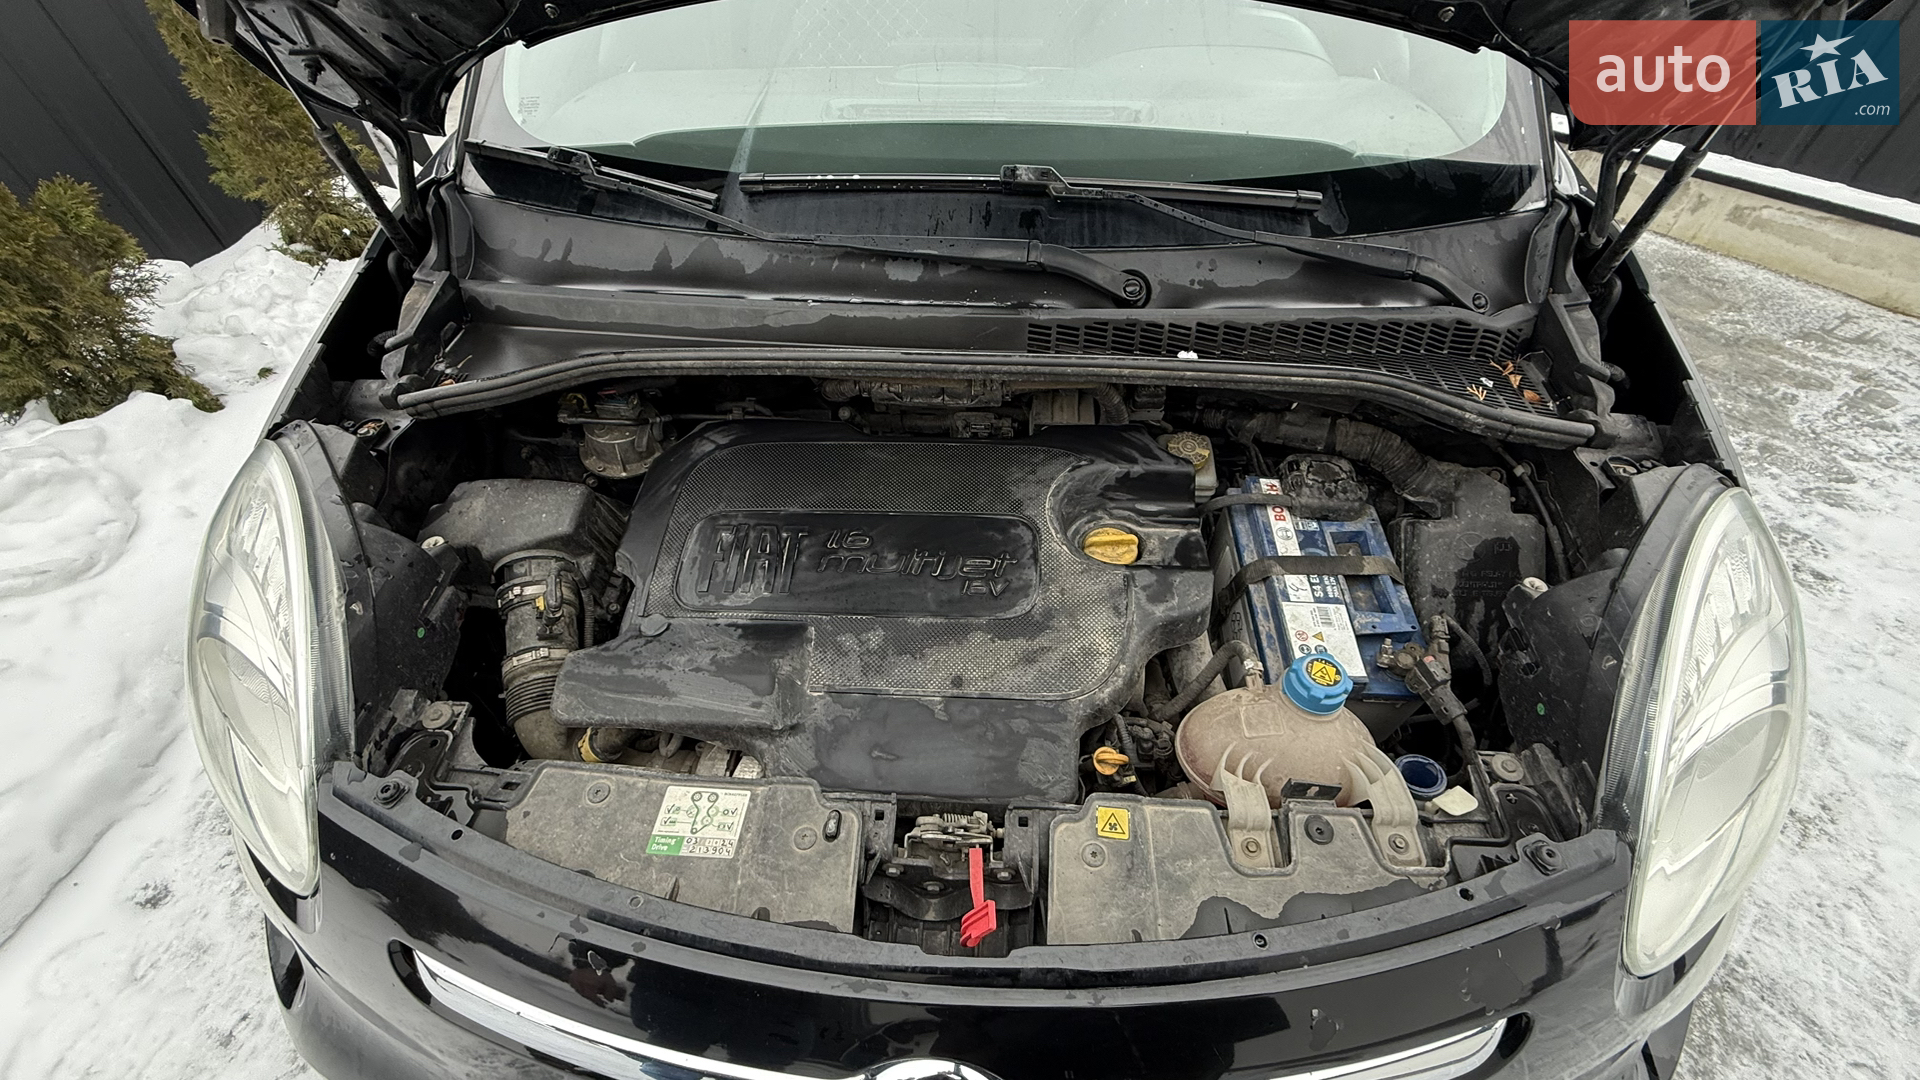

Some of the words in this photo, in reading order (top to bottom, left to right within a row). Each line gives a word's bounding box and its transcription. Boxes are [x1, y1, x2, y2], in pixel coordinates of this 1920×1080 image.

[1265, 483, 1287, 521] BOH
[697, 523, 808, 594] FIAT
[817, 548, 1018, 580] multijet
[961, 579, 1010, 597] 16V
[651, 843, 668, 851] Drive
[654, 836, 677, 845] Timing
[685, 837, 698, 845] 03
[688, 845, 731, 856] 213904
